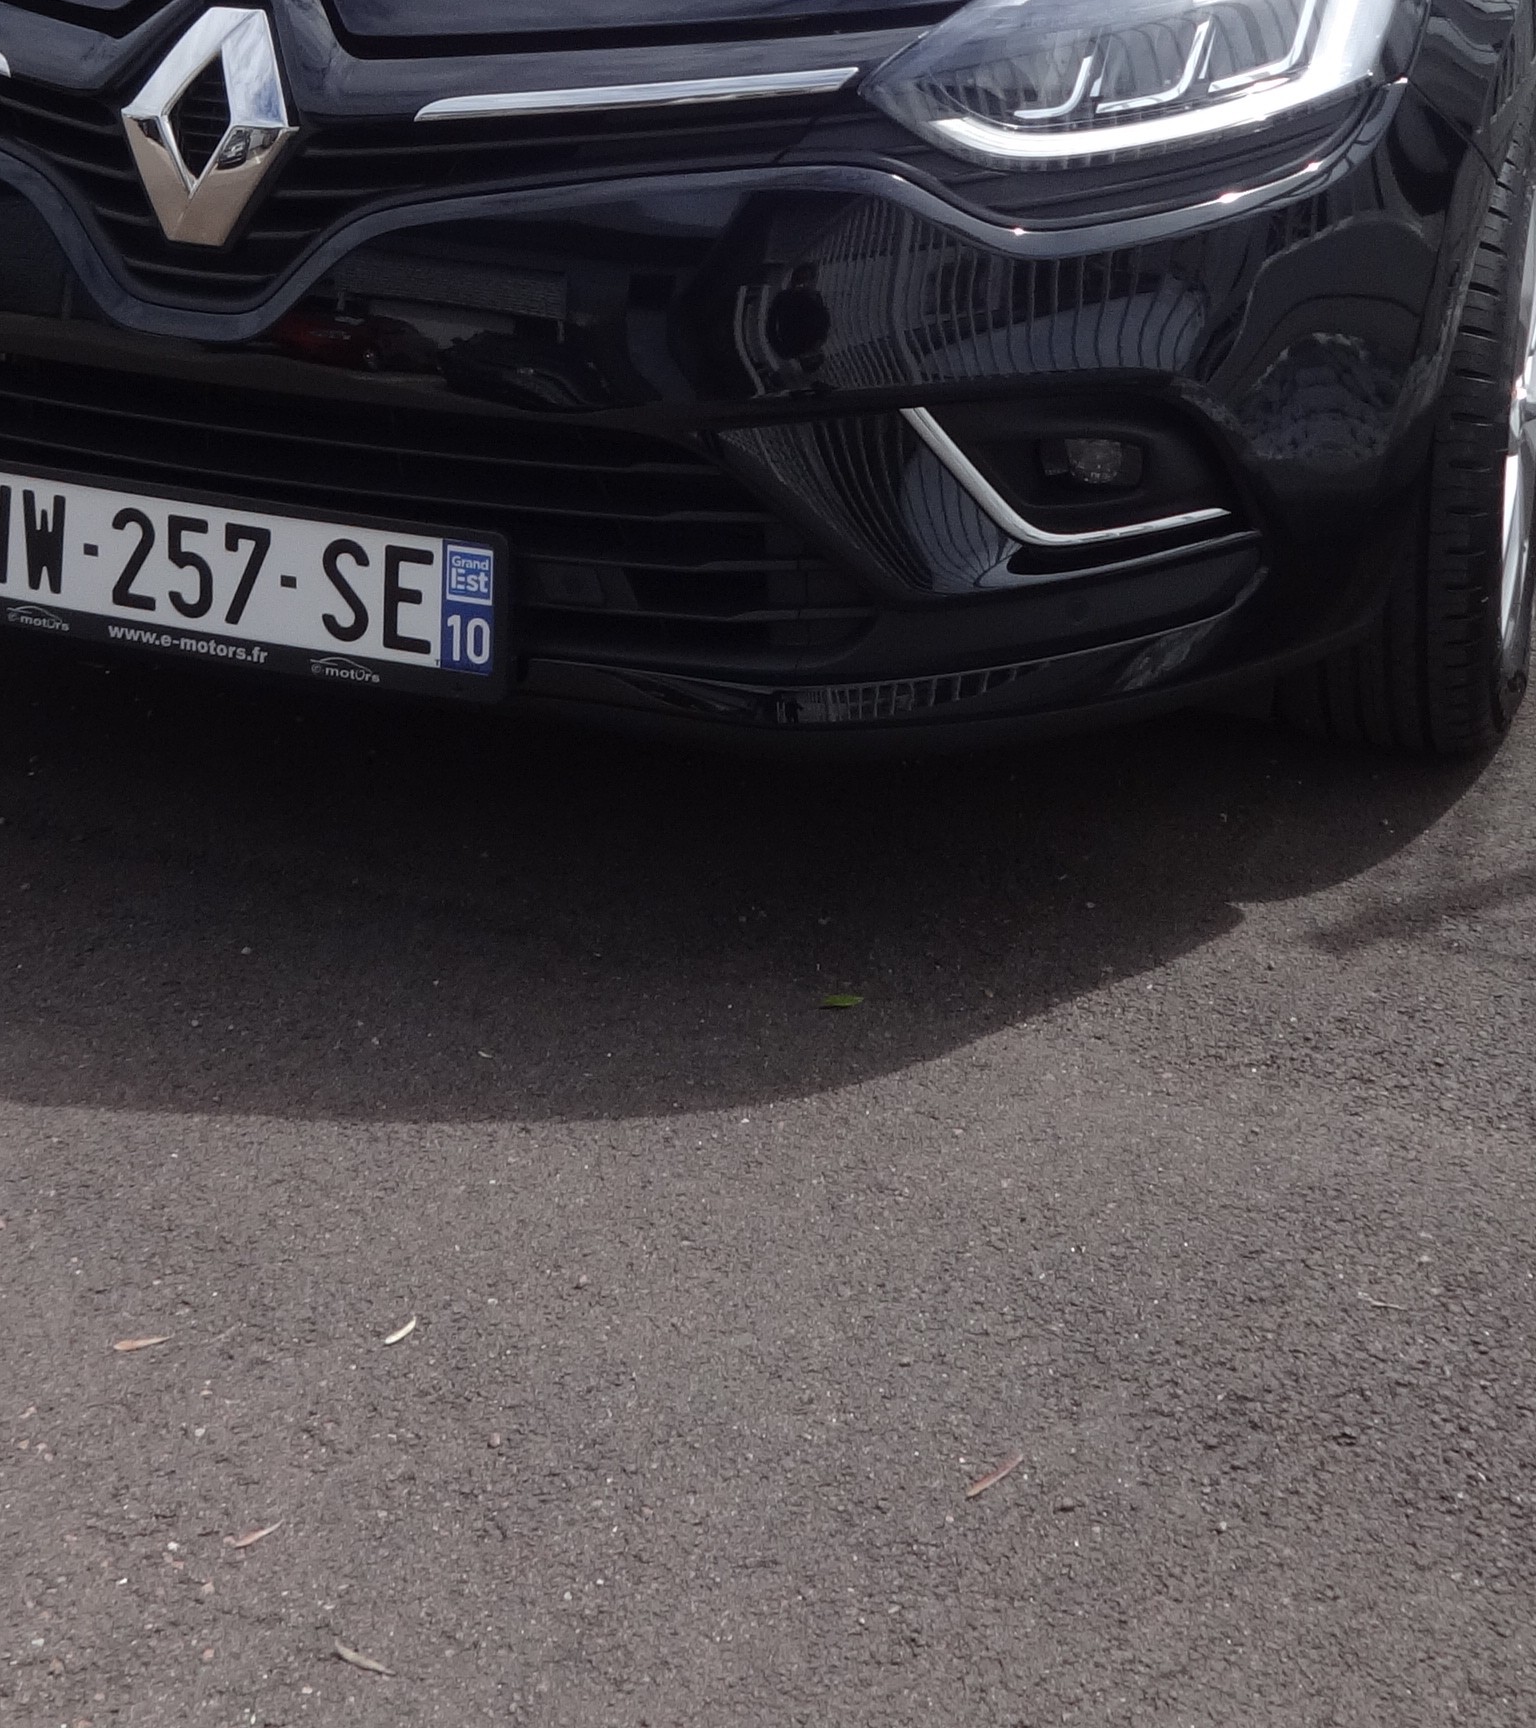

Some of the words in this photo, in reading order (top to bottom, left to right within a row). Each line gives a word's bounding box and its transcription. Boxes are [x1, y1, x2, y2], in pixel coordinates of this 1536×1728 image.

[451, 555, 489, 571] Grand
[451, 568, 489, 593] Est
[107, 624, 268, 664] www.e-motors.fr
[447, 614, 491, 664] 10
